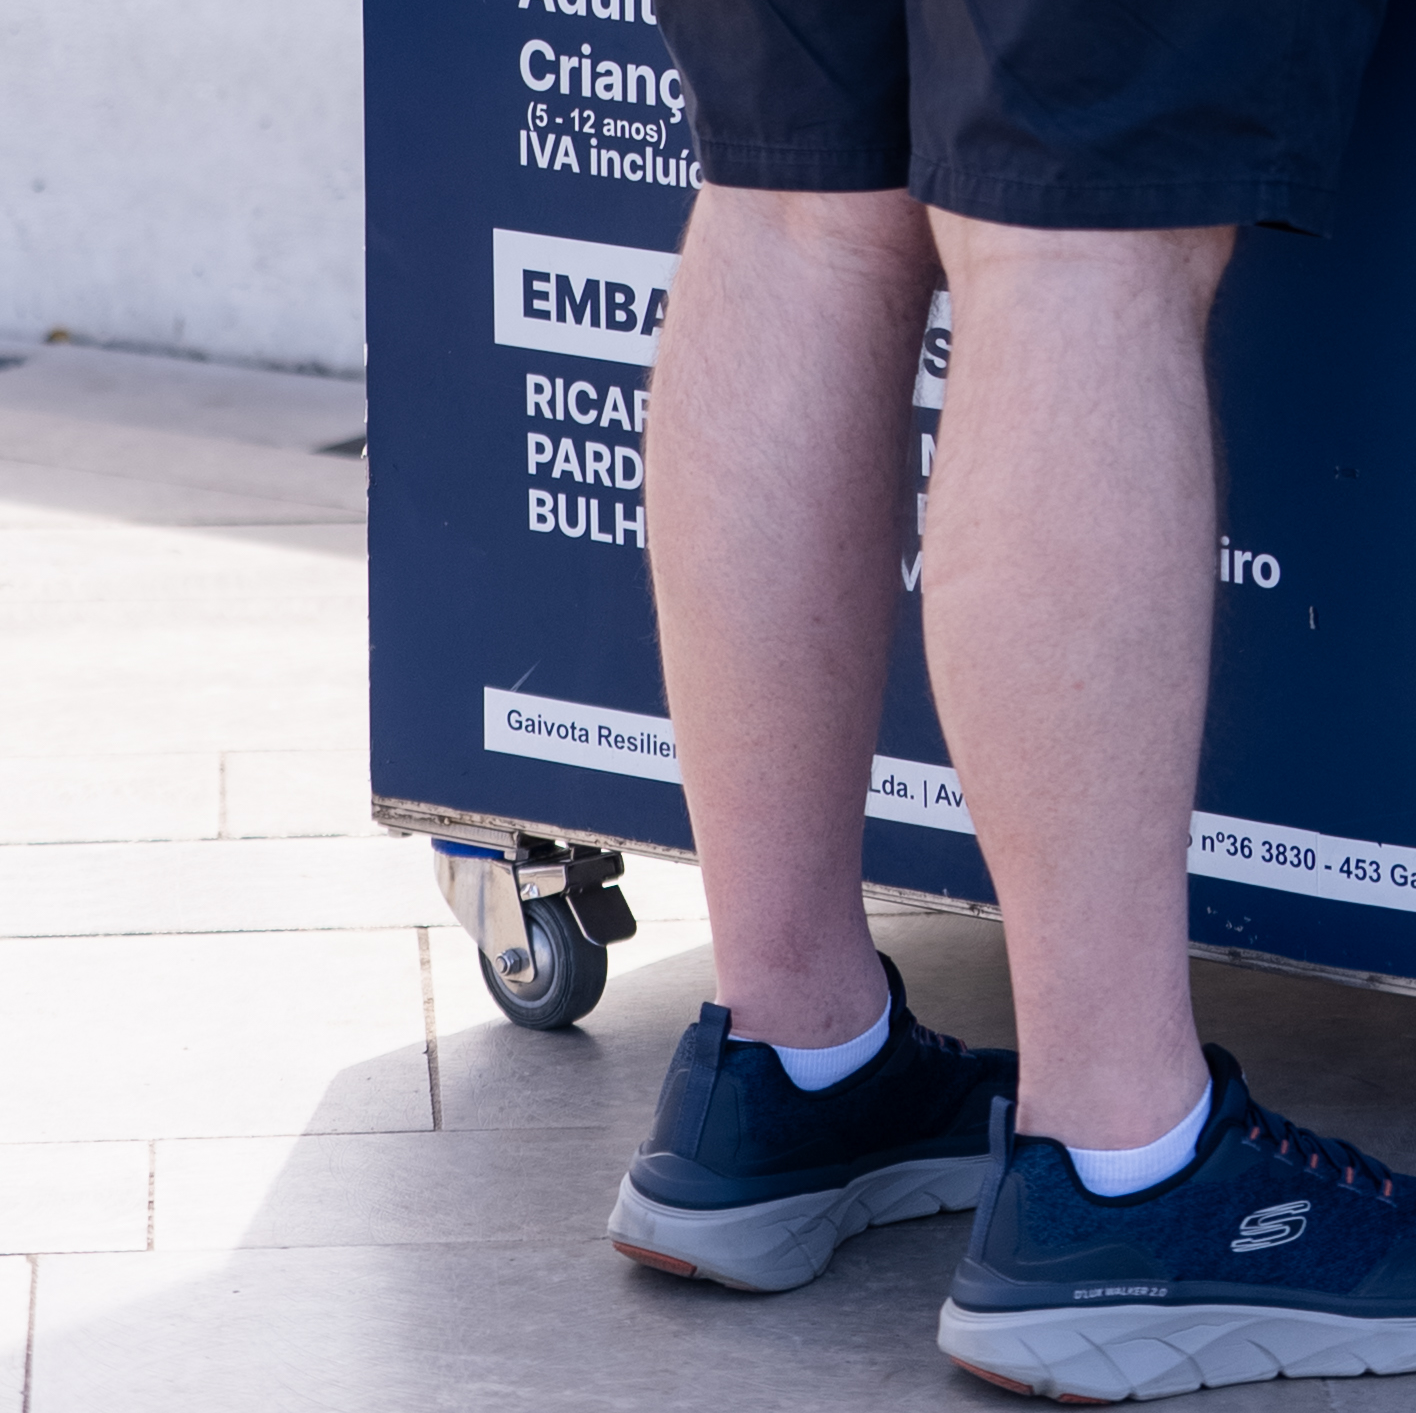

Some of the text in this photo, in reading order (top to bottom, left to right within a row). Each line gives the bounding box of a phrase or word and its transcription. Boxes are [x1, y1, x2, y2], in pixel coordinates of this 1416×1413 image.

[527, 102, 547, 131] (5
[570, 108, 595, 133] 12
[602, 118, 667, 150] anos)
[519, 129, 580, 174] IVA
[506, 709, 590, 744] Gaivota
[868, 774, 915, 801] Lda.
[1201, 831, 1253, 860] nº36
[1261, 840, 1316, 871] 3830
[1339, 856, 1381, 883] 453
